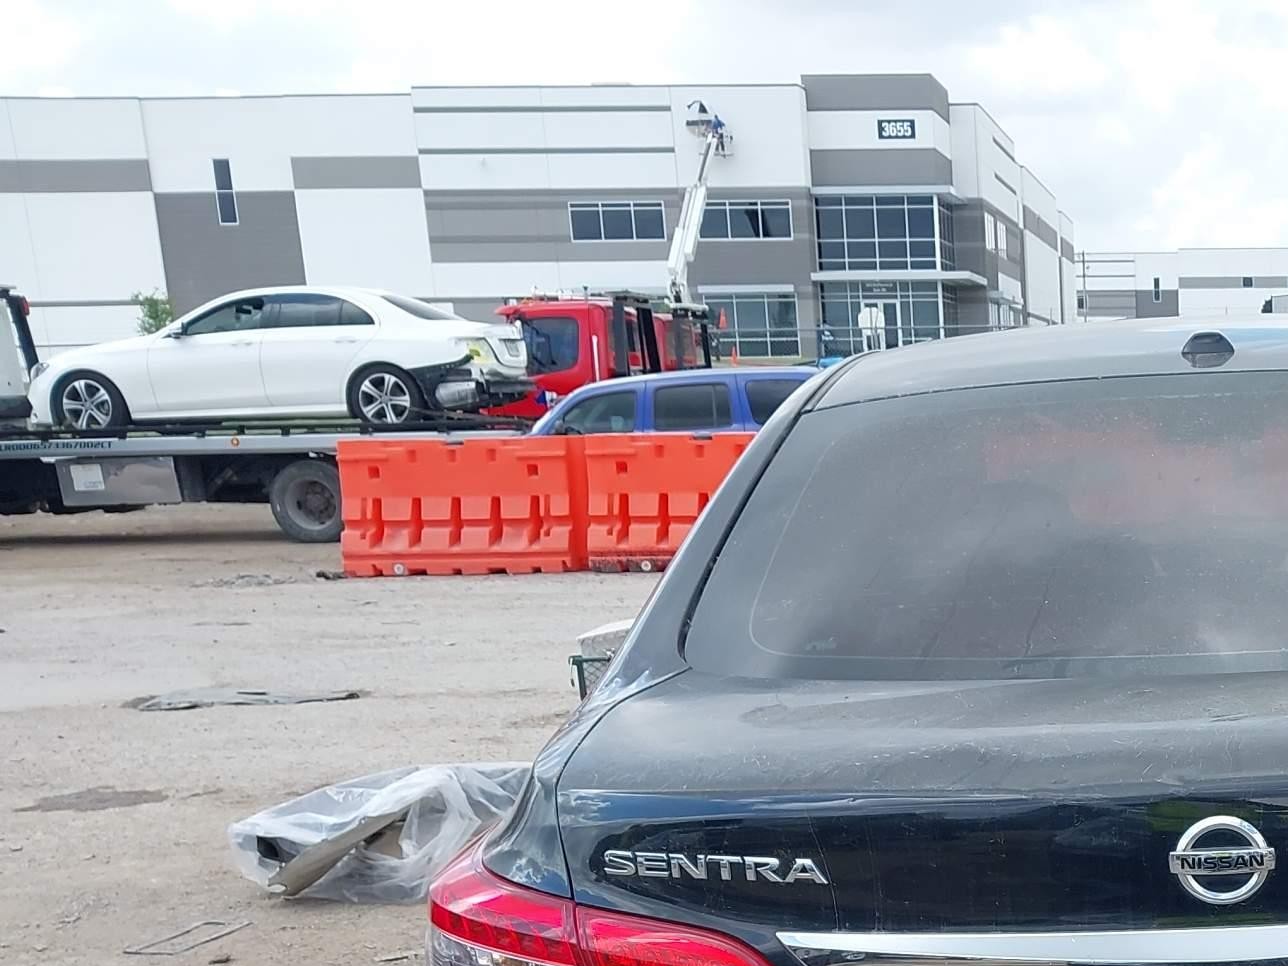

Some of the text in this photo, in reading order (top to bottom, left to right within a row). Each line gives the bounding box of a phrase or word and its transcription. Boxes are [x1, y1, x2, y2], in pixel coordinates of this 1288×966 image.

[881, 121, 912, 137] 3655
[603, 849, 829, 884] SENTRA
[1180, 853, 1265, 870] NISSAN
